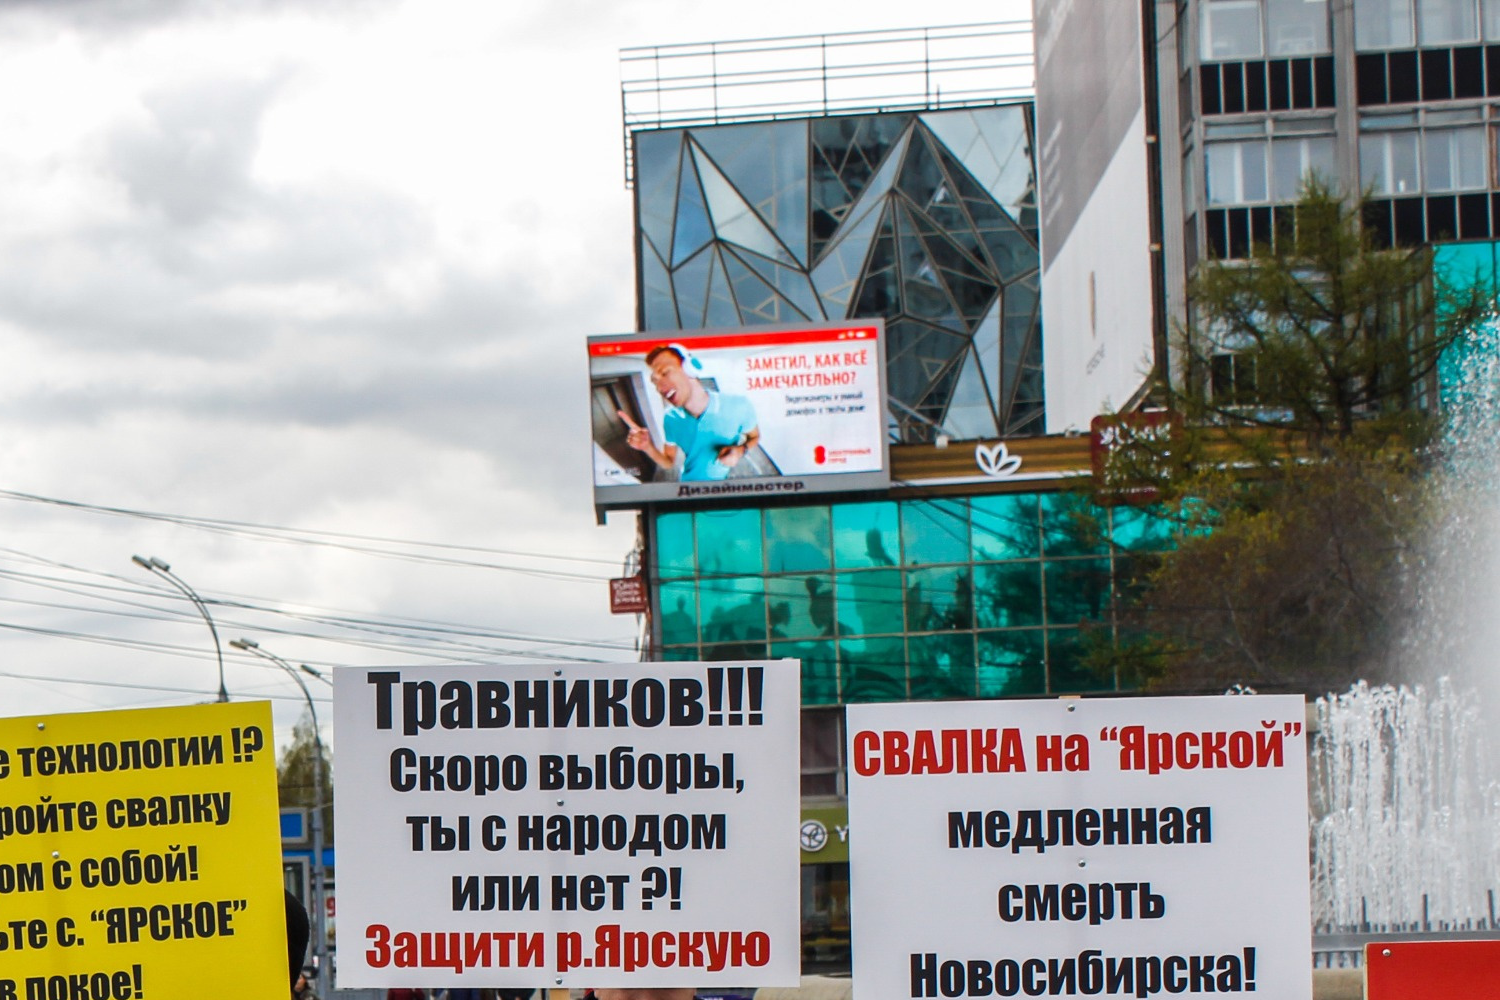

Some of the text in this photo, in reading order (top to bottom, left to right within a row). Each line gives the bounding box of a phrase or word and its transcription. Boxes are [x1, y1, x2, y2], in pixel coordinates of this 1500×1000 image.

[746, 350, 868, 373] ЗАМЕТИЛ, КАК ВСЁ
[747, 372, 856, 391] ЗАМЕЧАТЕЛЬНО?
[678, 480, 804, 497] Дизайнмастер
[368, 667, 763, 735] Травников!!!
[17, 735, 223, 776] технологии
[231, 726, 263, 762] !?
[391, 747, 743, 795] Скоро выборы,
[854, 722, 1301, 776] СВАЛКА на “Ярской”
[106, 792, 230, 828] свалку
[949, 807, 1211, 853] медленная
[406, 814, 725, 856] ты с народом
[53, 861, 71, 889] с
[81, 845, 198, 888] собой!
[453, 867, 681, 911] или нет ?!
[56, 918, 84, 947] с.
[91, 900, 246, 943] “ЯРСКОЕ”
[999, 883, 1164, 925] смерть
[366, 925, 770, 973] Защити р.Ярскую
[911, 947, 1255, 998] Новосибирска!
